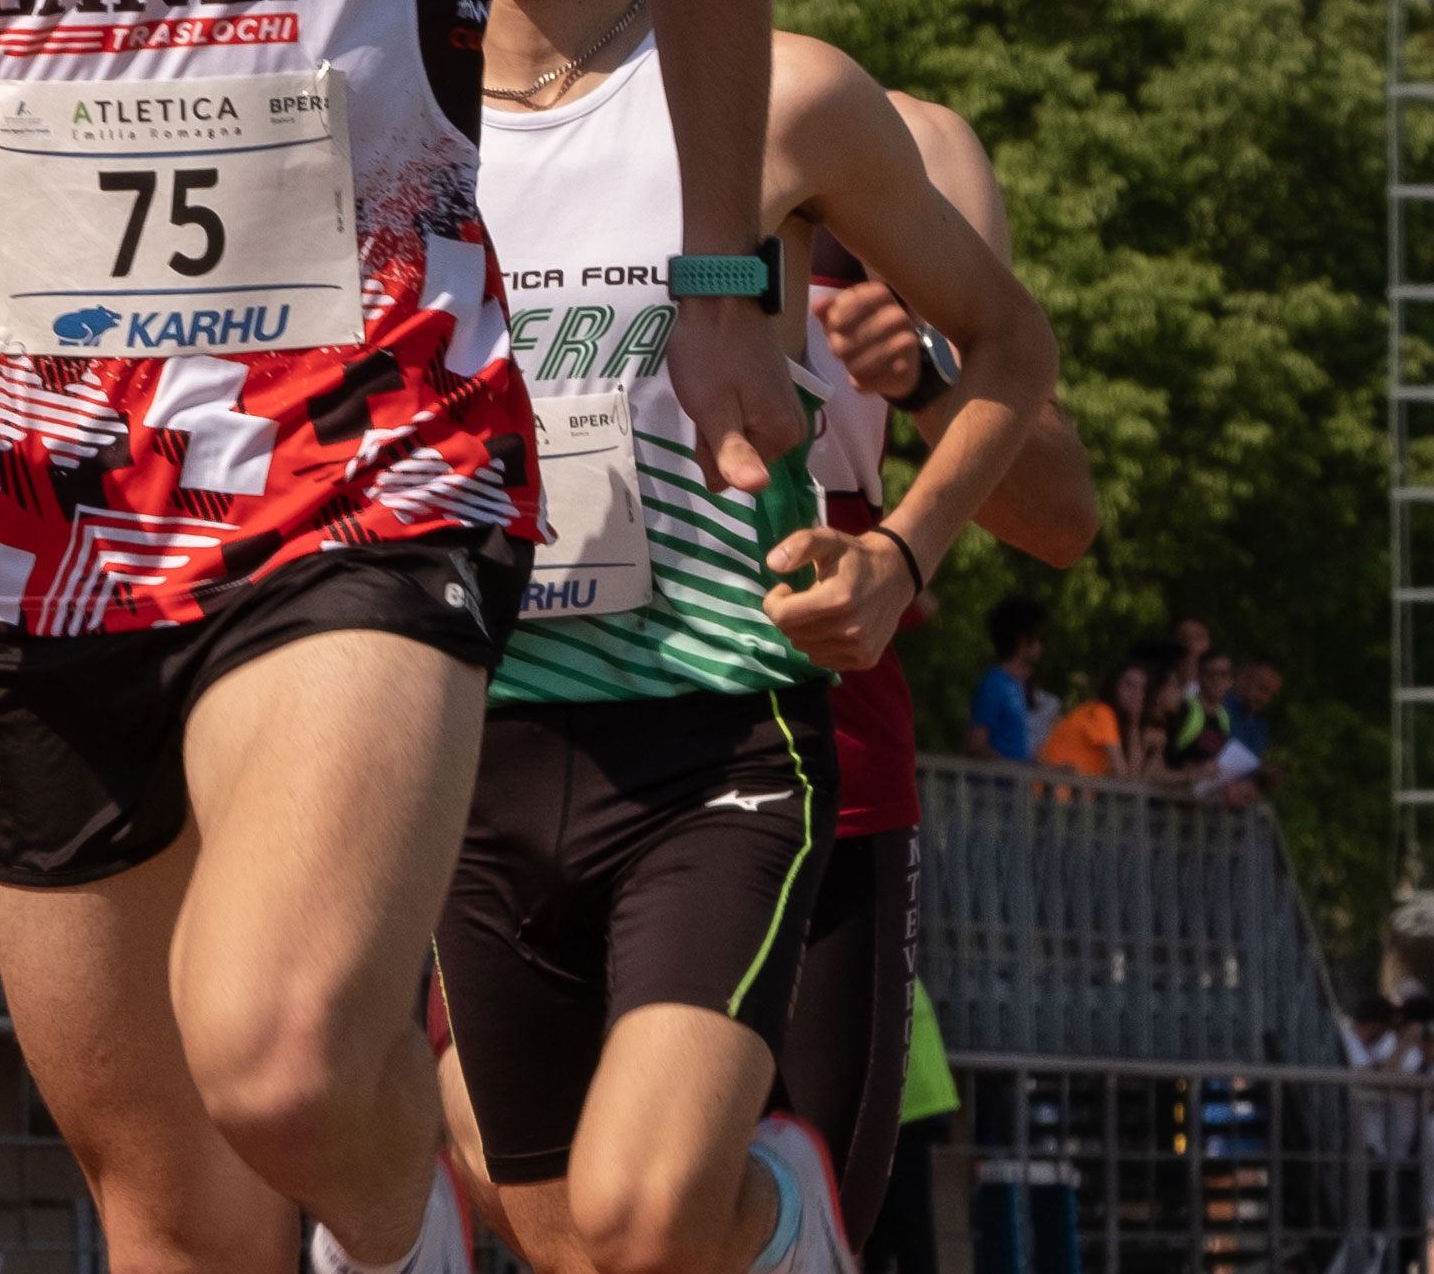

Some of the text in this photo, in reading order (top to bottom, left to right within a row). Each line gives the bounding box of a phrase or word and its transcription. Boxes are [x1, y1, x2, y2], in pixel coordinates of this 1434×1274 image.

[111, 15, 295, 51] TRASLOCHI
[72, 96, 239, 125] ATLETICA
[72, 126, 243, 142] Emilia Romagna
[97, 167, 226, 279] 75
[581, 265, 669, 287] FORL
[126, 304, 290, 348] KARHU
[510, 304, 680, 381] ERA
[520, 578, 598, 612] RHU
